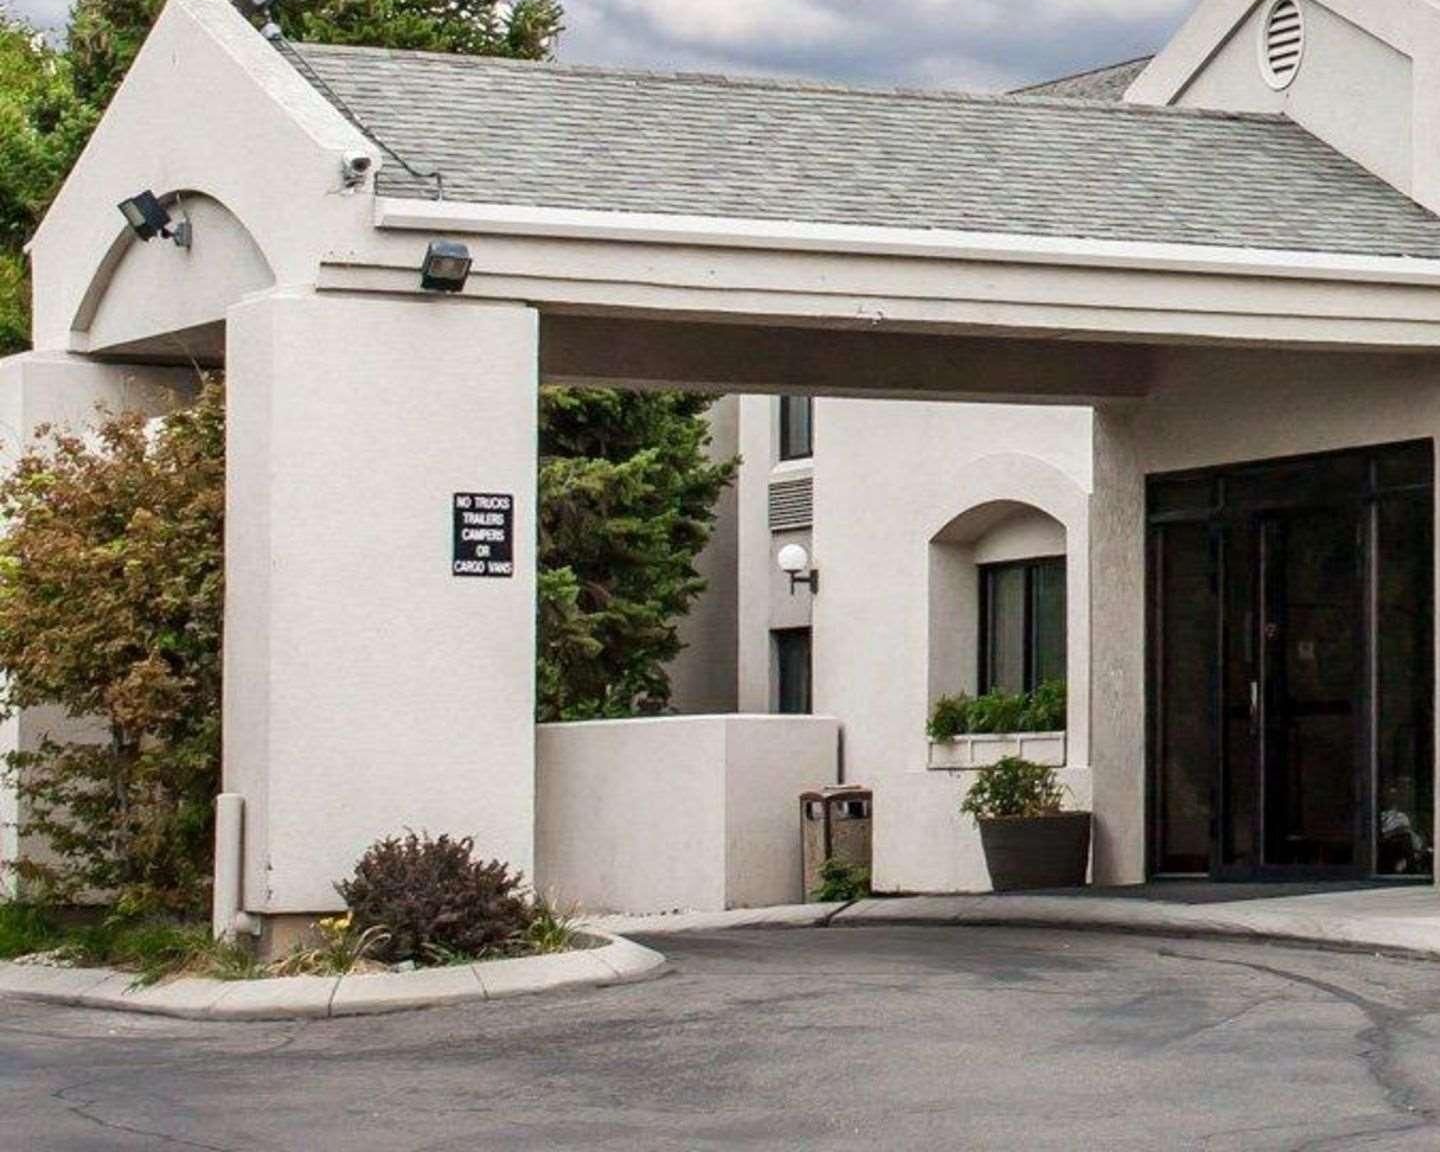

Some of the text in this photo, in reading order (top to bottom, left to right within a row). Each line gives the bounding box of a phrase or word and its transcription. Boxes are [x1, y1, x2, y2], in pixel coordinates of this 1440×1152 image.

[456, 496, 510, 510] NO TRUCKS
[462, 512, 504, 526] TRAILERS
[461, 528, 505, 541] CAMPERS
[475, 545, 490, 557] OR
[454, 560, 512, 574] CARGO VANS
